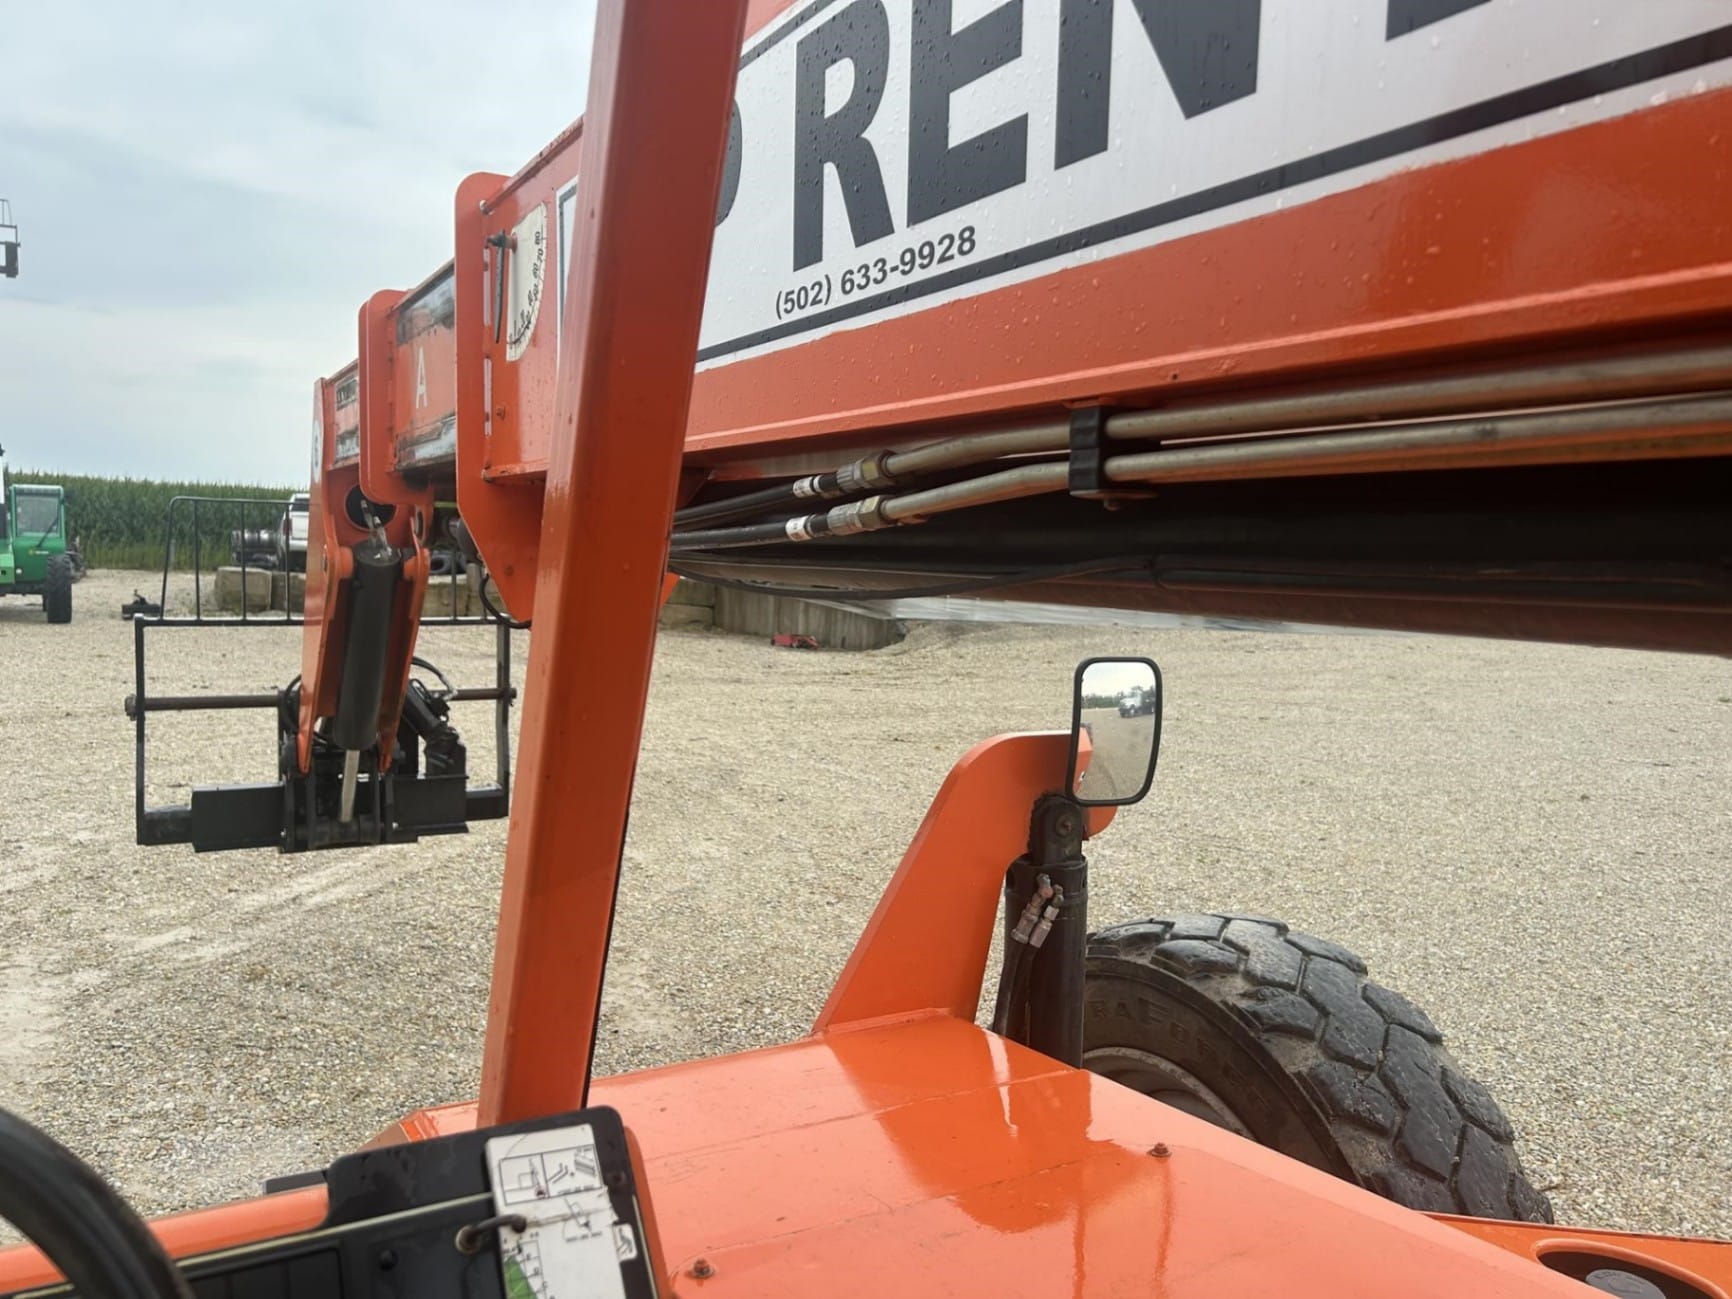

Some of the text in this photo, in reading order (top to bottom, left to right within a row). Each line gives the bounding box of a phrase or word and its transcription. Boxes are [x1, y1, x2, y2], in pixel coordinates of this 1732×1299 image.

[793, 0, 1490, 272] REN
[775, 225, 976, 320] (502) 633-9928
[415, 346, 428, 408] A
